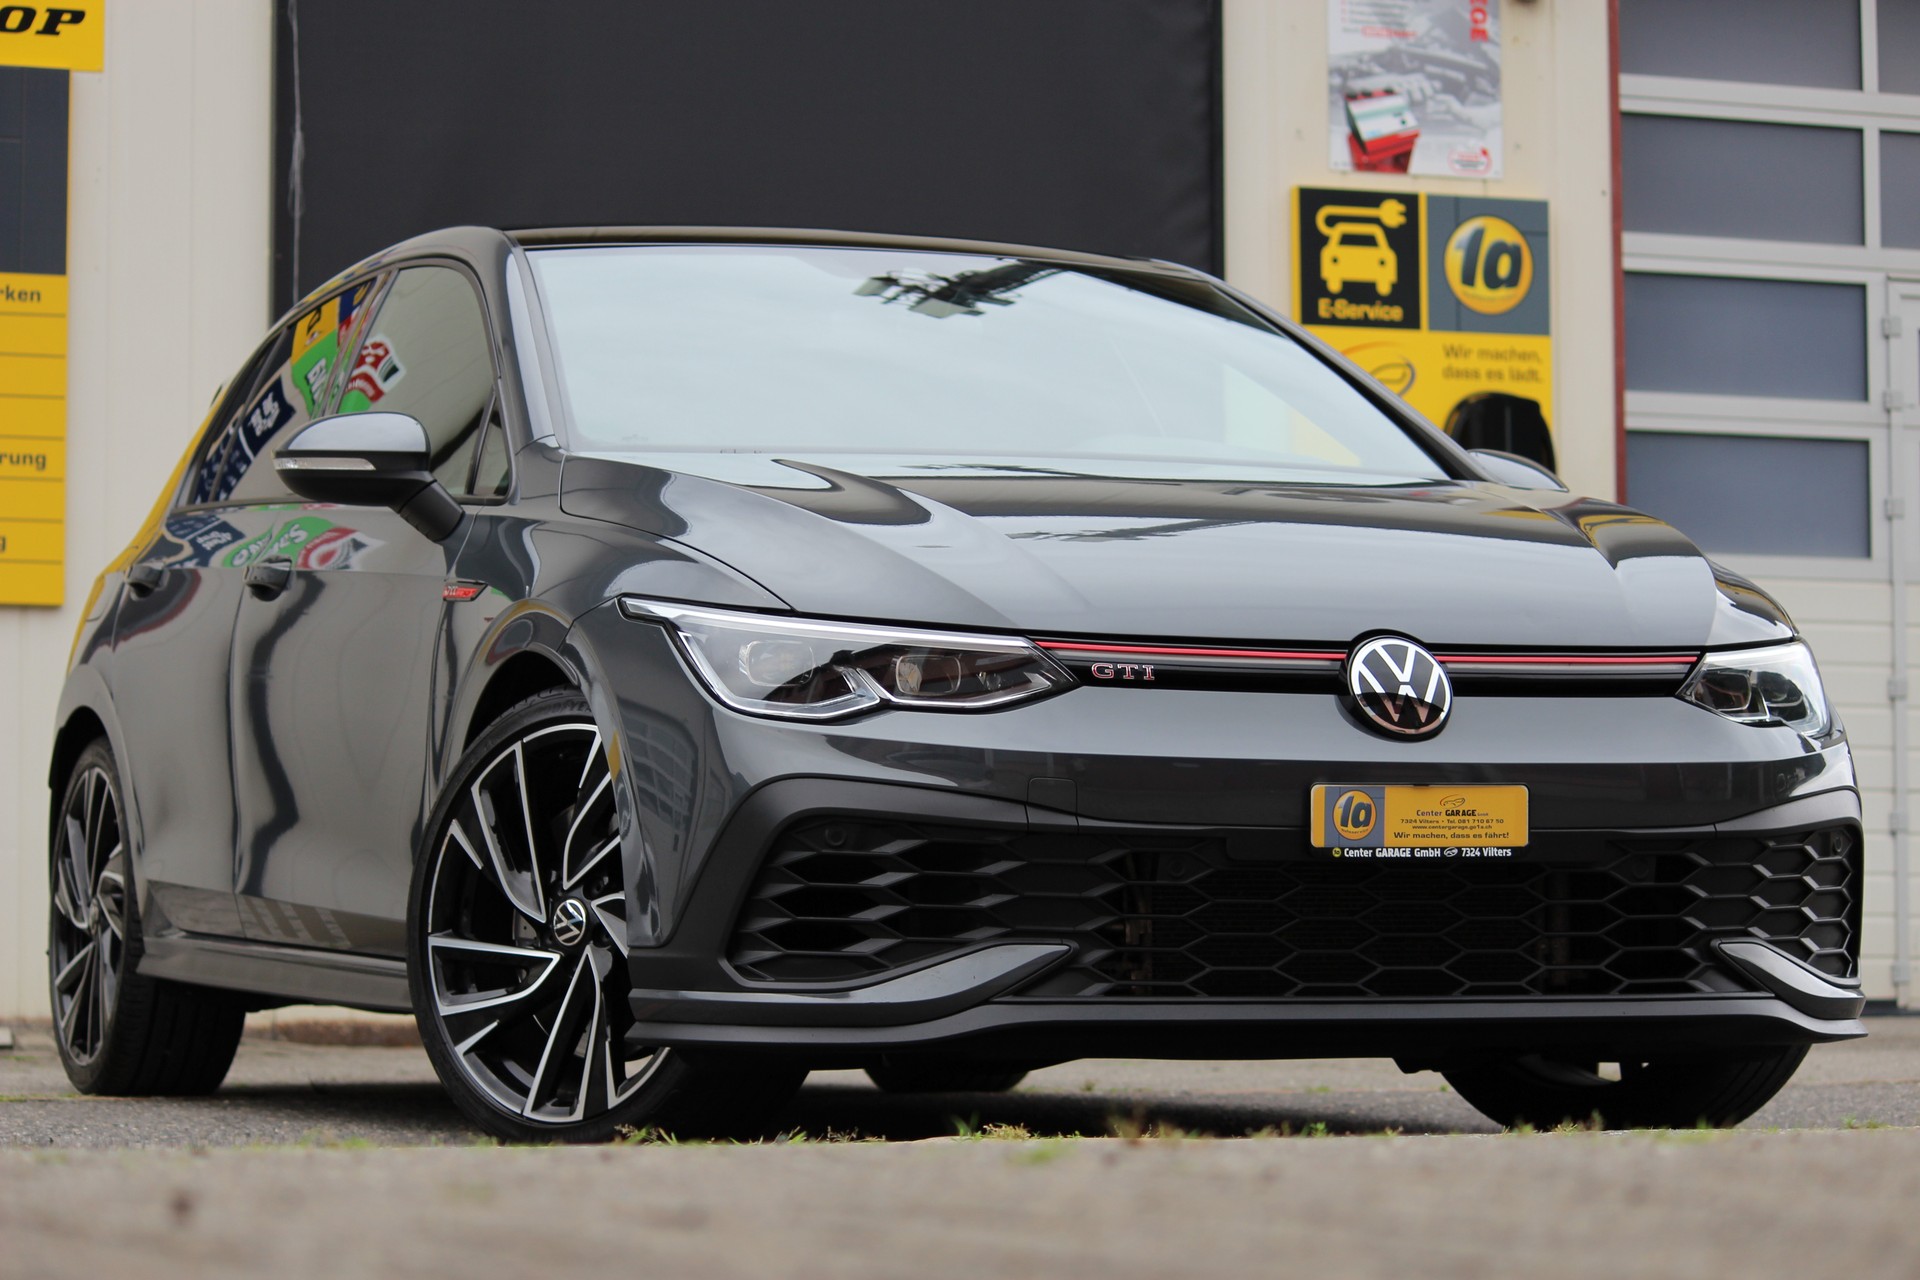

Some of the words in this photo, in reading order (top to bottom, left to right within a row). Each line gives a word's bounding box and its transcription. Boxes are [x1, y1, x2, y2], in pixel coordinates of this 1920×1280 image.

[1318, 298, 1404, 321] E-Service
[1441, 344, 1472, 359] Wir
[1476, 346, 1543, 364] machen,
[1442, 366, 1481, 380] dass
[1485, 369, 1504, 381] es
[1091, 662, 1156, 681] GTI
[1416, 809, 1443, 817] Center
[1445, 809, 1477, 817] GARAGE
[1412, 832, 1449, 840] machen,
[1344, 847, 1373, 858] Center
[1375, 847, 1412, 858] GARAGE
[1414, 847, 1441, 858] GmbH
[1461, 847, 1481, 857] 7324
[1482, 846, 1512, 858] Vilters
